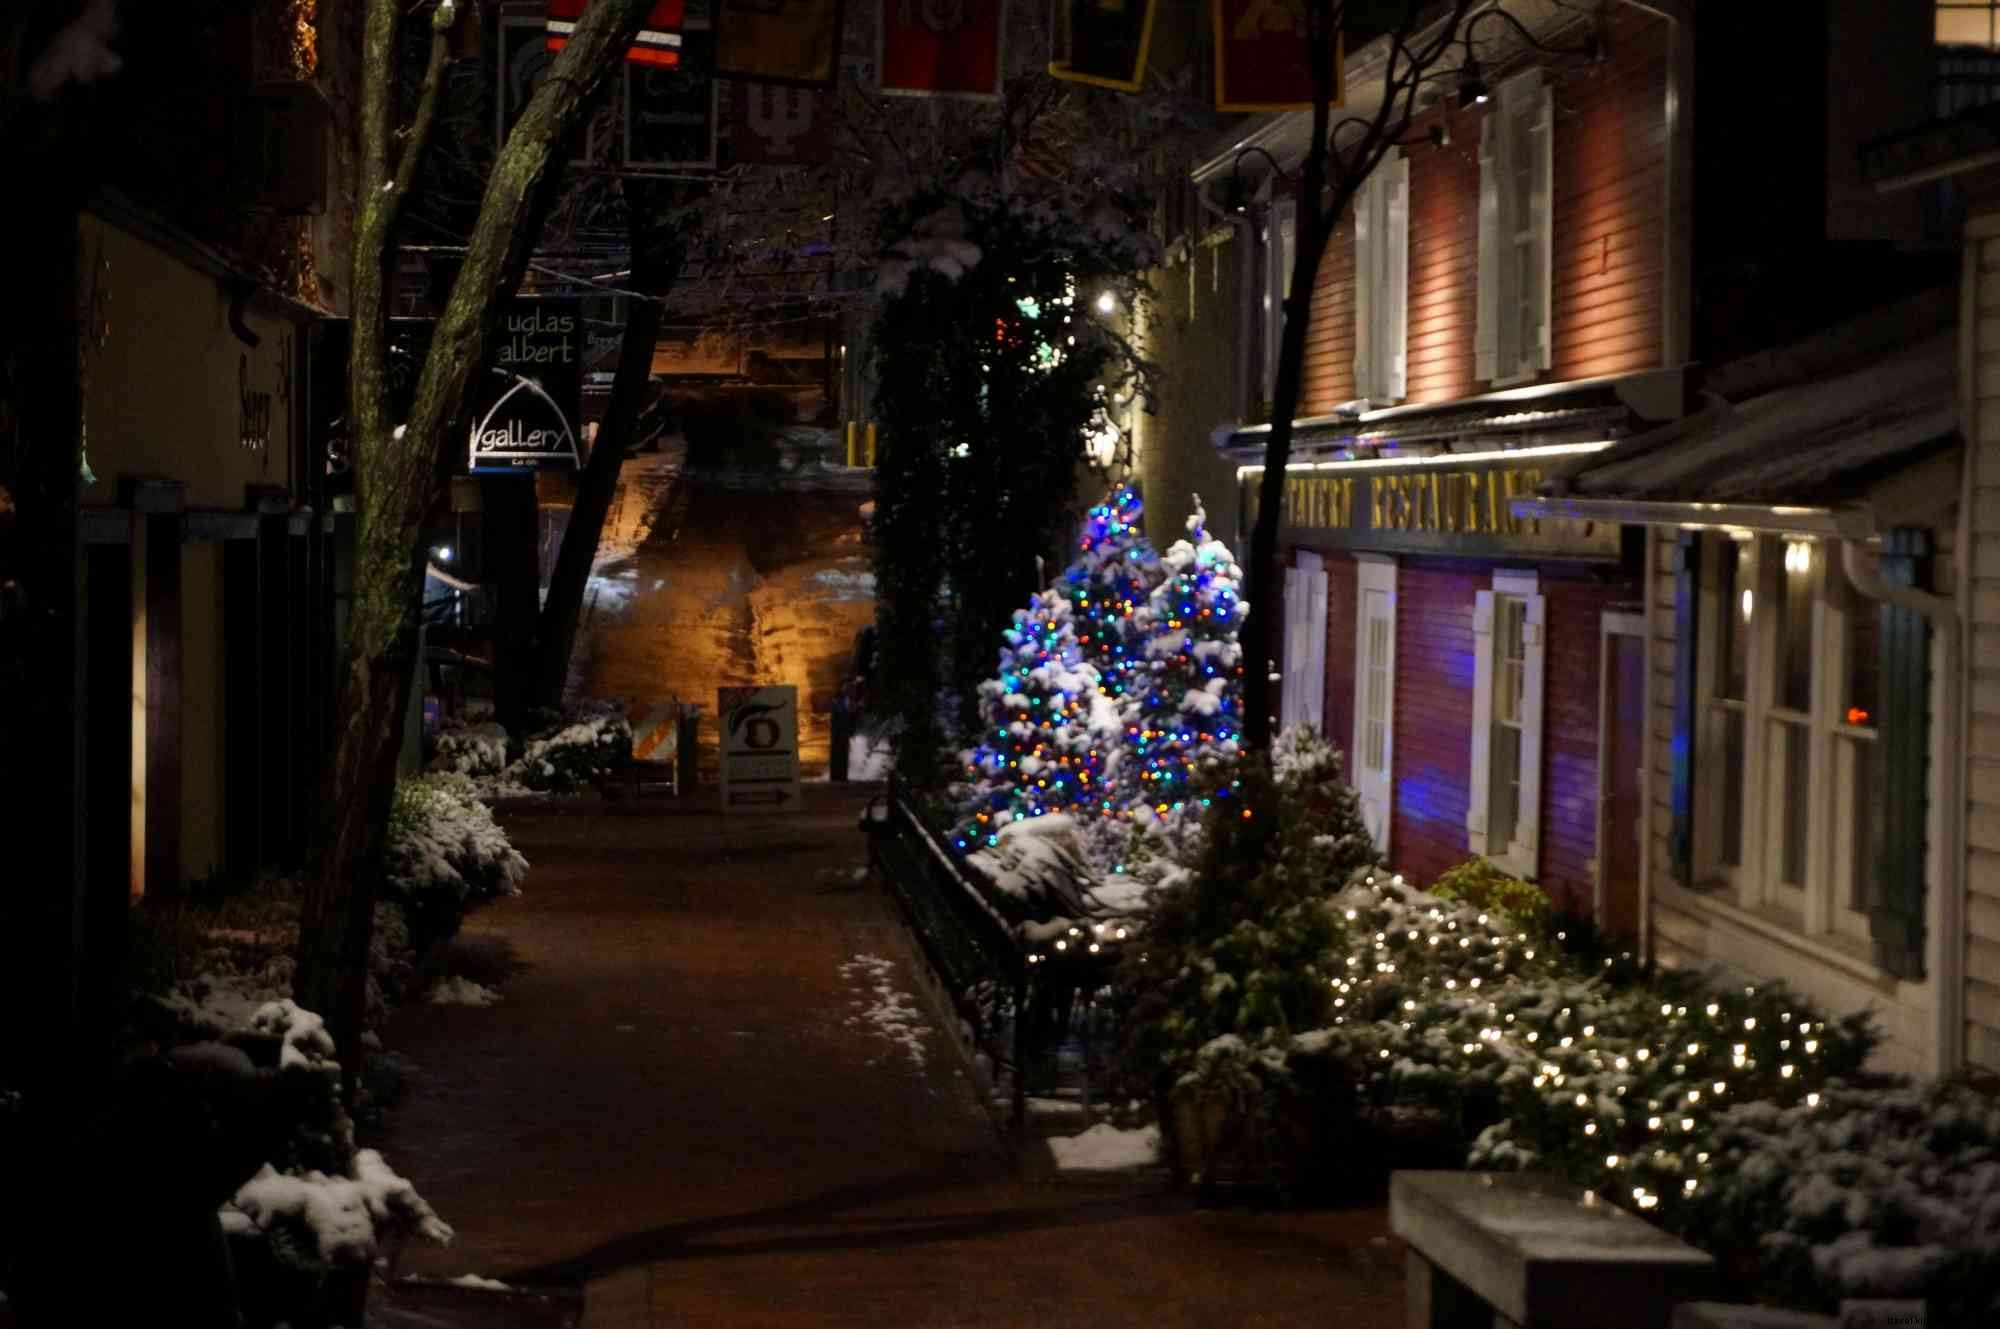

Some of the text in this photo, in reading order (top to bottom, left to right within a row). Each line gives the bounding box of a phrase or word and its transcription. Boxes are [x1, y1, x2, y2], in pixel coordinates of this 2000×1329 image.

[507, 304, 575, 337] uglas
[499, 335, 575, 363] albert
[481, 418, 567, 451] gallery
